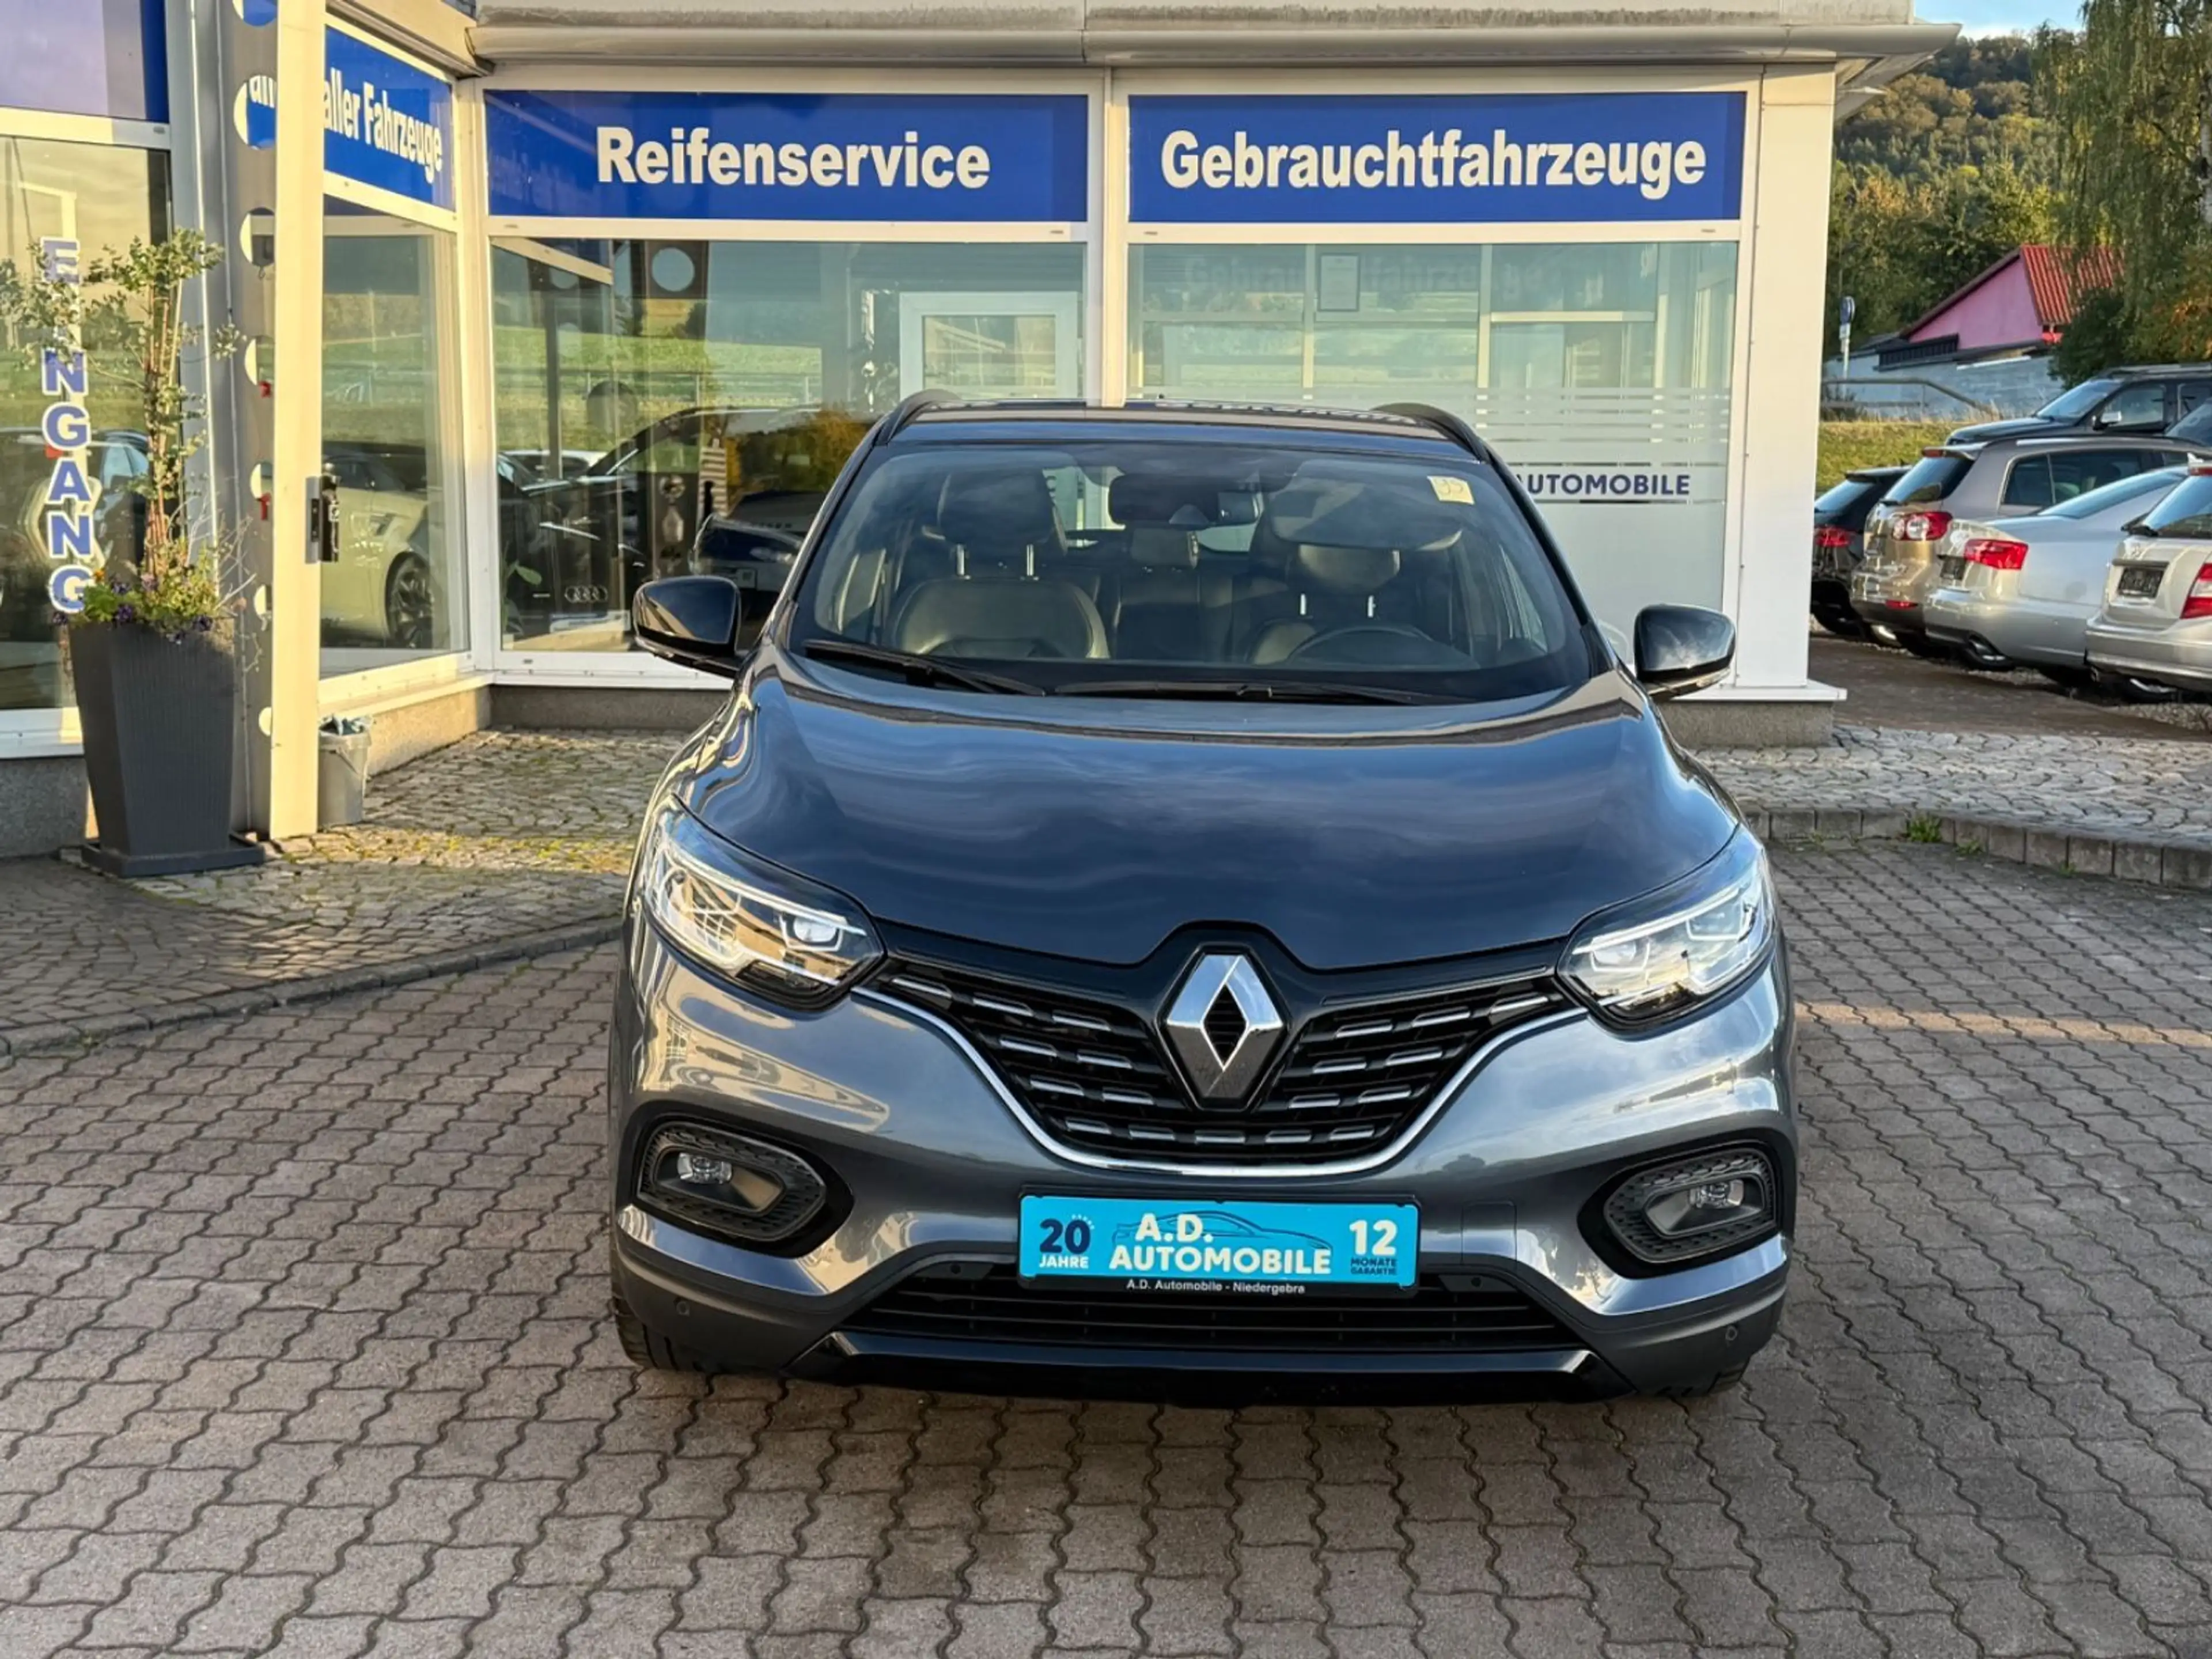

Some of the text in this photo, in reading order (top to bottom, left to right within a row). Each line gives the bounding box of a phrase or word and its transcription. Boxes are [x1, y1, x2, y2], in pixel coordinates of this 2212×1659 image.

[324, 67, 443, 184] aller Fahrzeuge
[597, 127, 990, 188] Reifenservice
[1161, 129, 1706, 200] Gebrauchtfahrzeuge
[41, 237, 93, 613] ENGANG
[1516, 474, 1690, 495] UTOMOBILE
[1039, 1218, 1090, 1254] 20
[1135, 1213, 1214, 1243] A.D.
[1349, 1219, 1397, 1256] 12
[1039, 1254, 1089, 1268] JAHRE
[1109, 1245, 1331, 1274] AUTOMOBILE
[1126, 1279, 1151, 1290] A.D.
[1154, 1279, 1223, 1291] Automobile
[1233, 1282, 1305, 1296] Niedergebra
